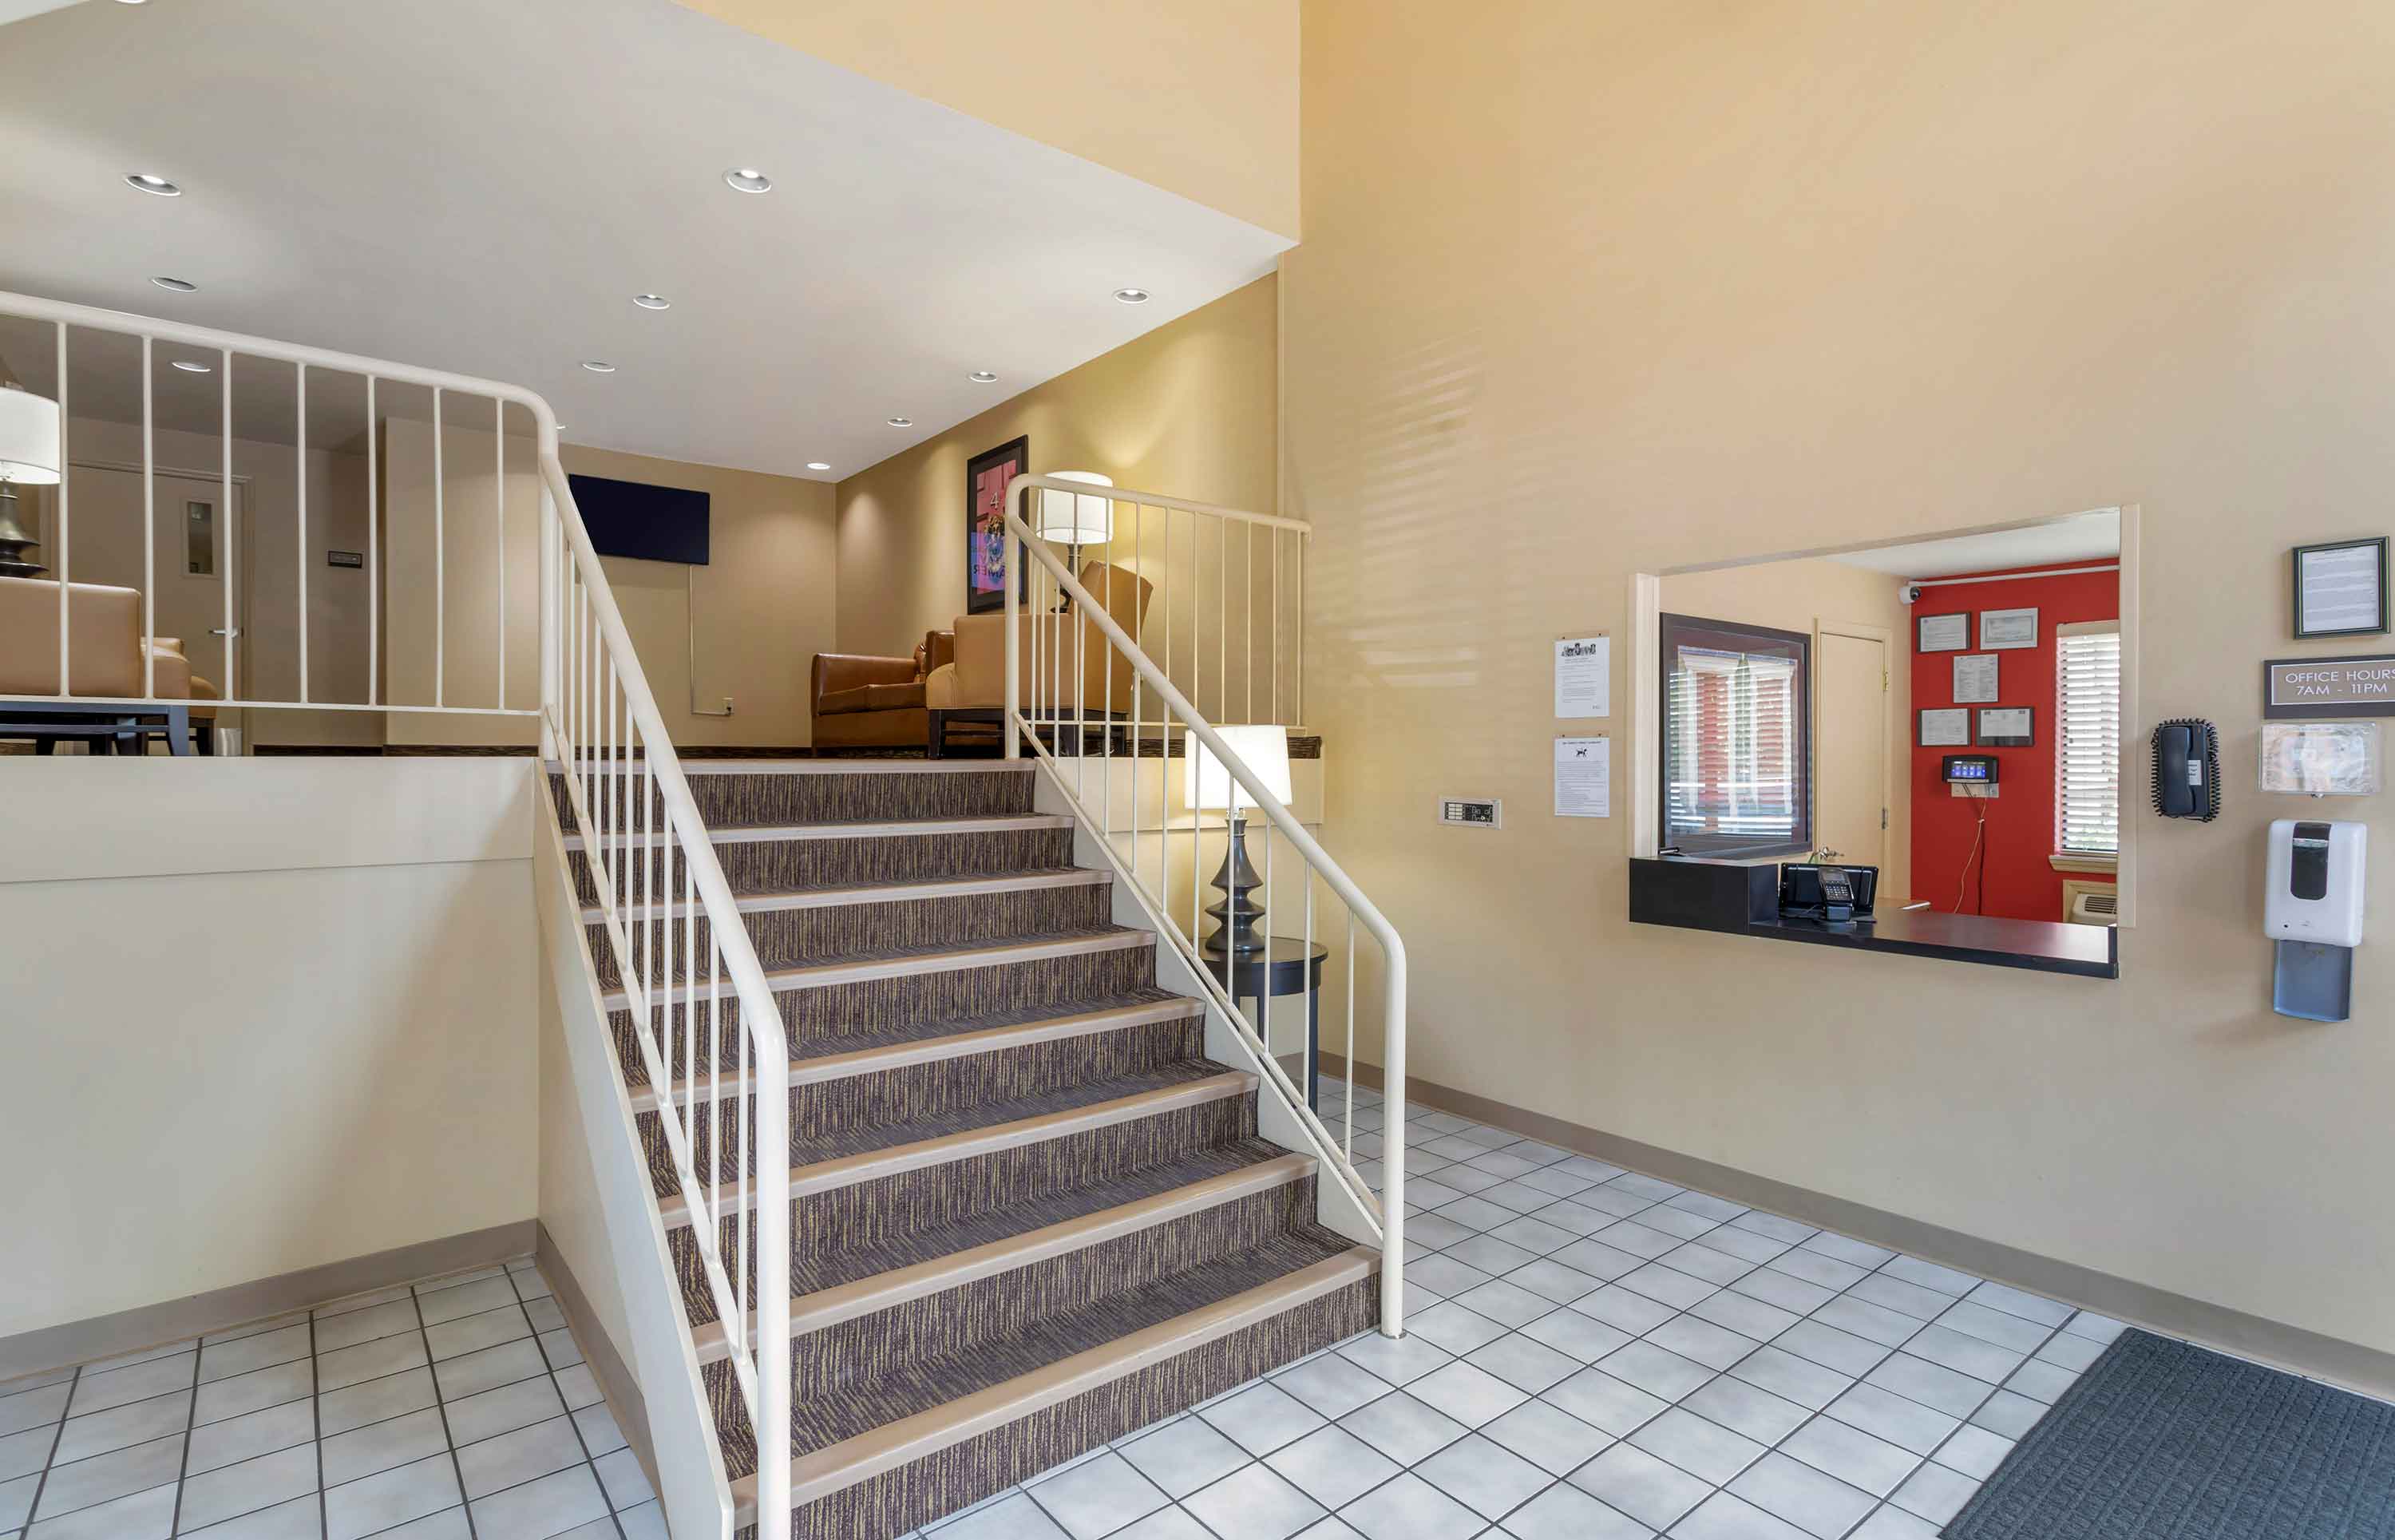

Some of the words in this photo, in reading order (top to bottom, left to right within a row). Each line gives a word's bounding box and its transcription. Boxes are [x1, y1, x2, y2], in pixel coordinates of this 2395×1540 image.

[2285, 671, 2338, 683] OFFICE
[2296, 685, 2330, 695] 7AM
[2351, 683, 2388, 694] 11PM
